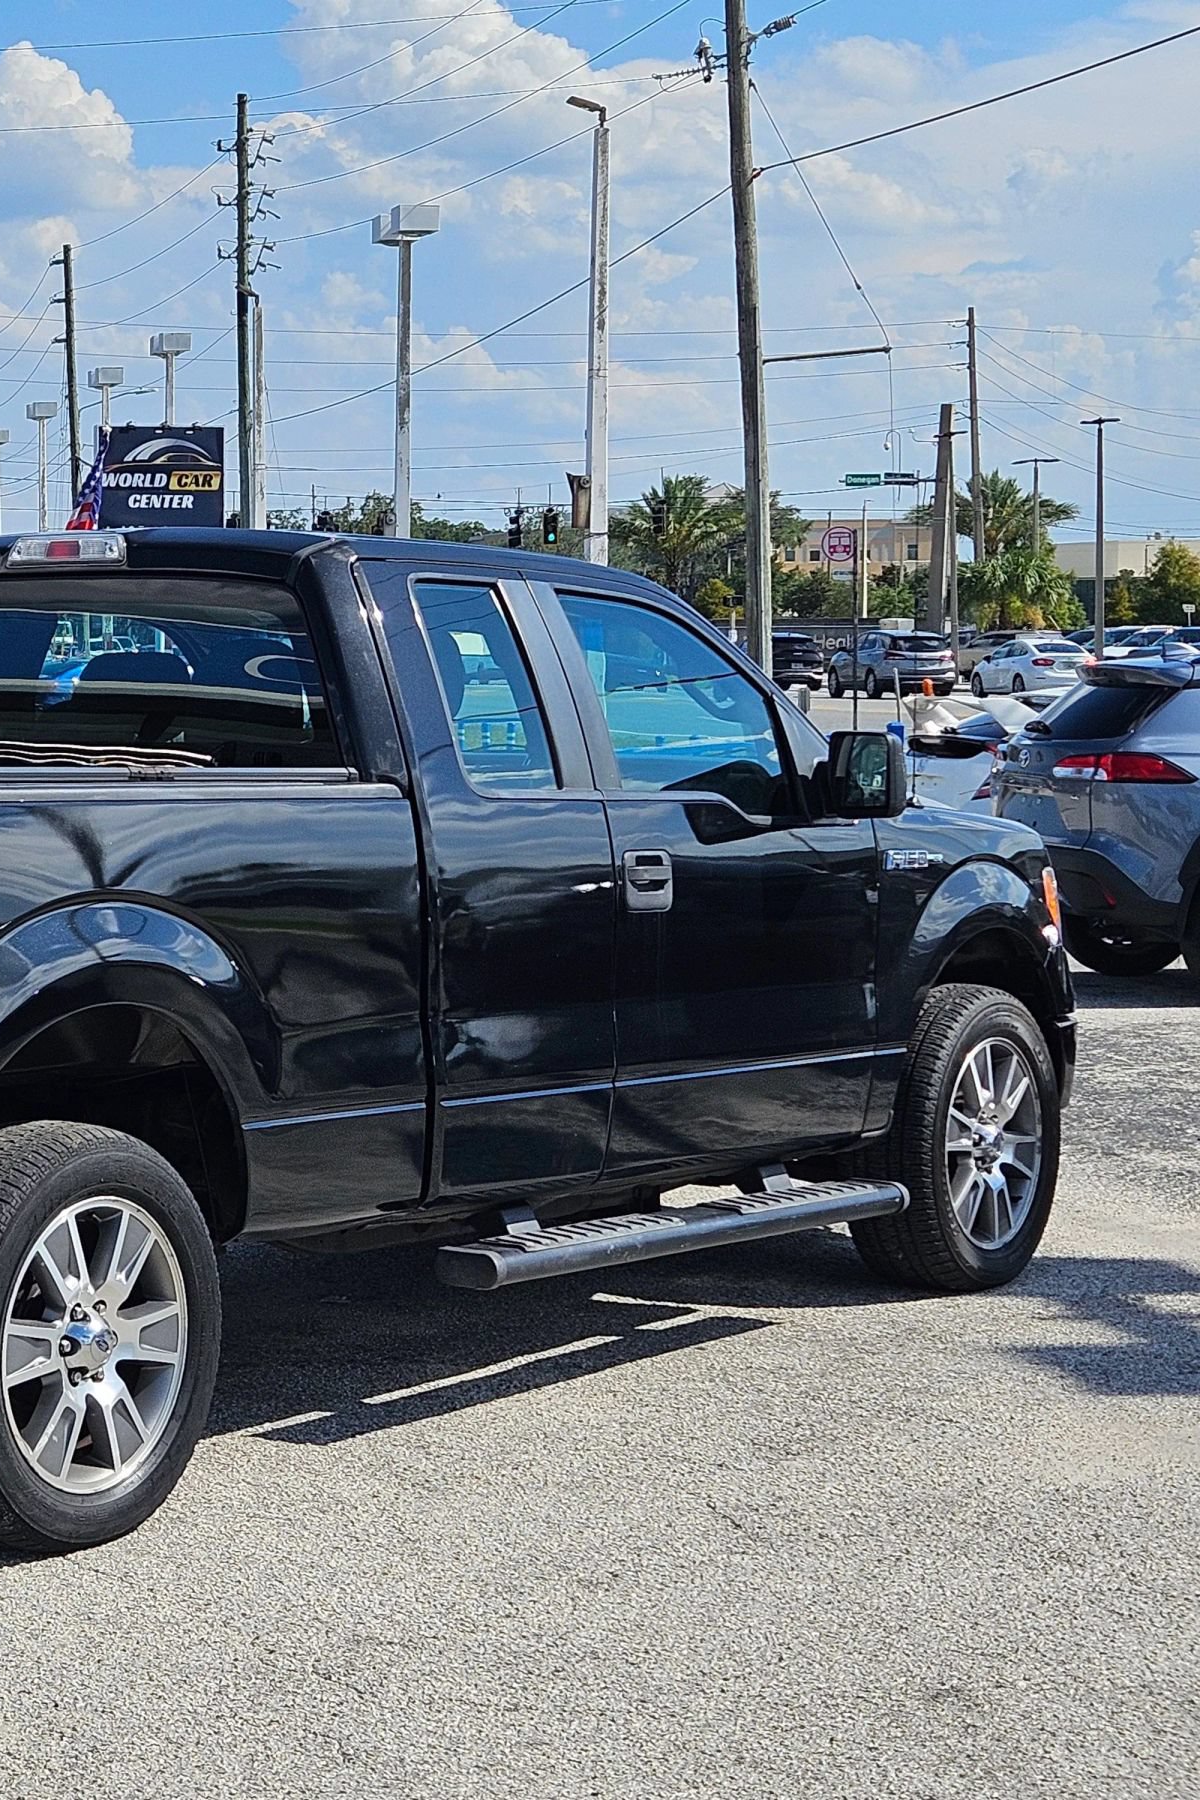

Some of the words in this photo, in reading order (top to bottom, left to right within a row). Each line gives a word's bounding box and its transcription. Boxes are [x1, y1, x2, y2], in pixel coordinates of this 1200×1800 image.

[102, 472, 168, 488] WORLD
[176, 473, 214, 488] CAR
[846, 475, 880, 485] Donegan
[127, 494, 194, 509] CENTER
